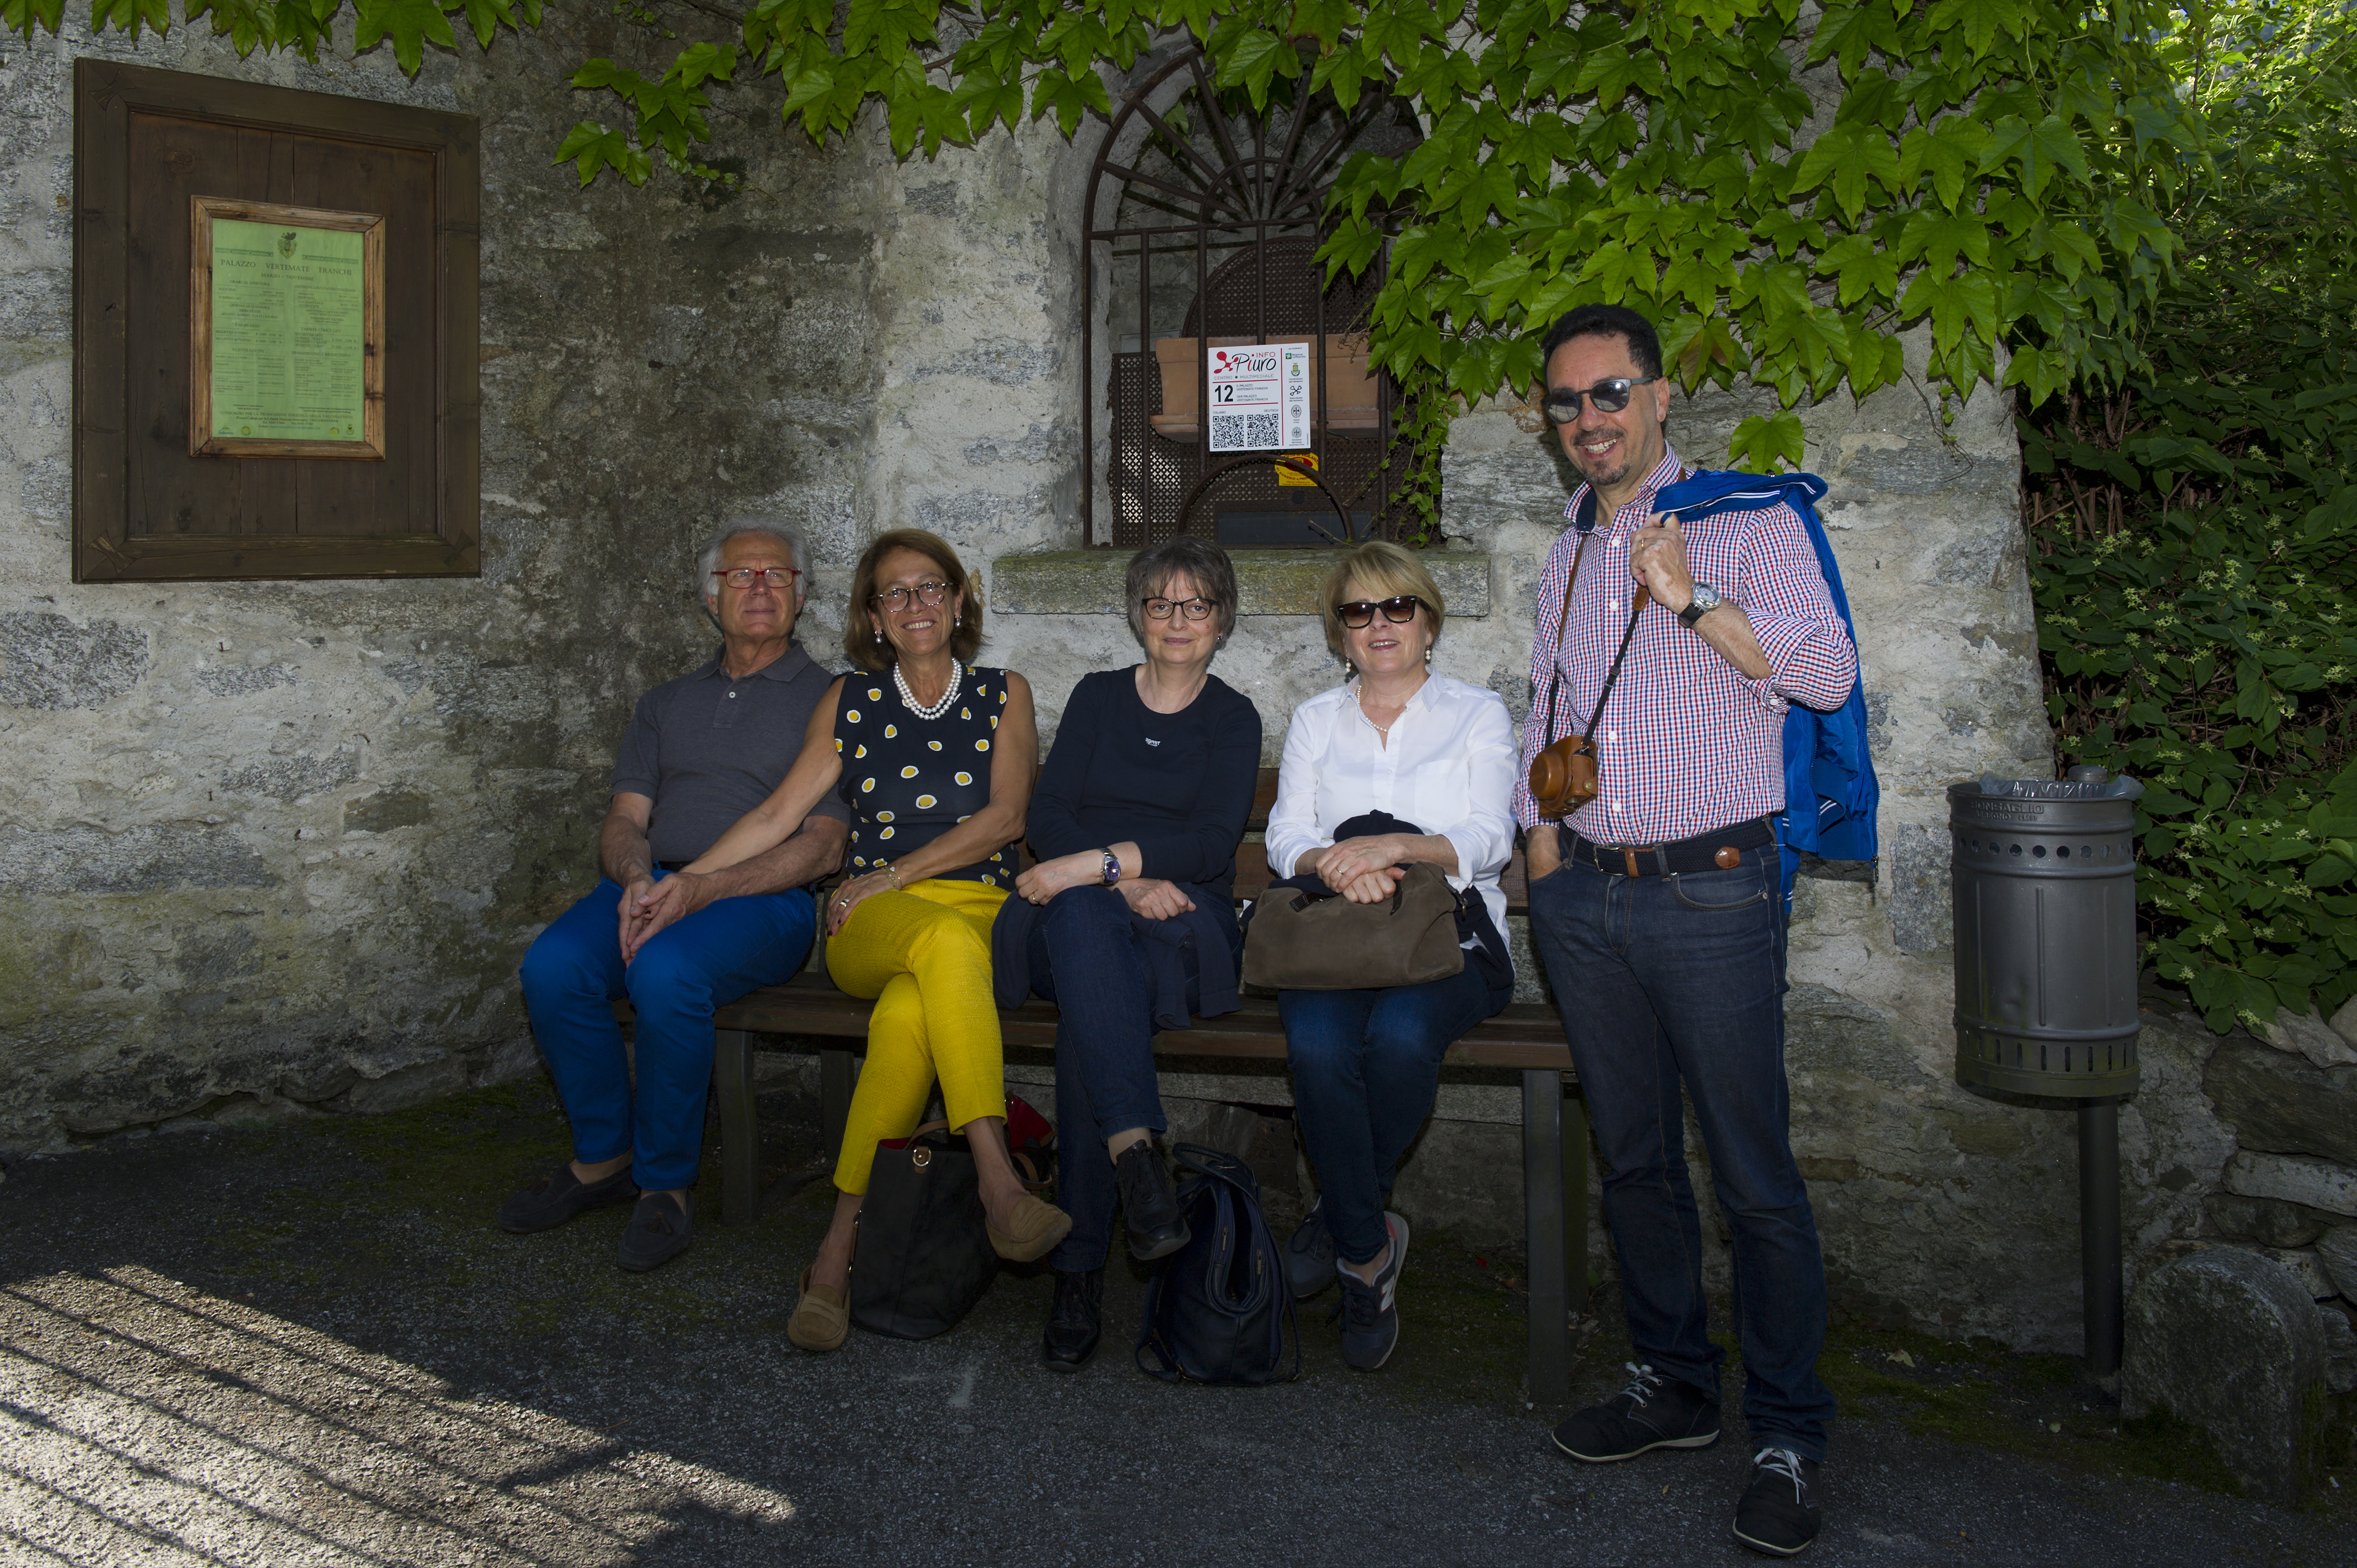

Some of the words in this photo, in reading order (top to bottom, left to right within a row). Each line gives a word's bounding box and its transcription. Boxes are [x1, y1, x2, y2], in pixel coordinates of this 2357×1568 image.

[221, 259, 256, 267] PALAZZO
[265, 263, 310, 272] VERTEMATE
[1232, 353, 1277, 373] Piuro
[1215, 385, 1233, 403] 12
